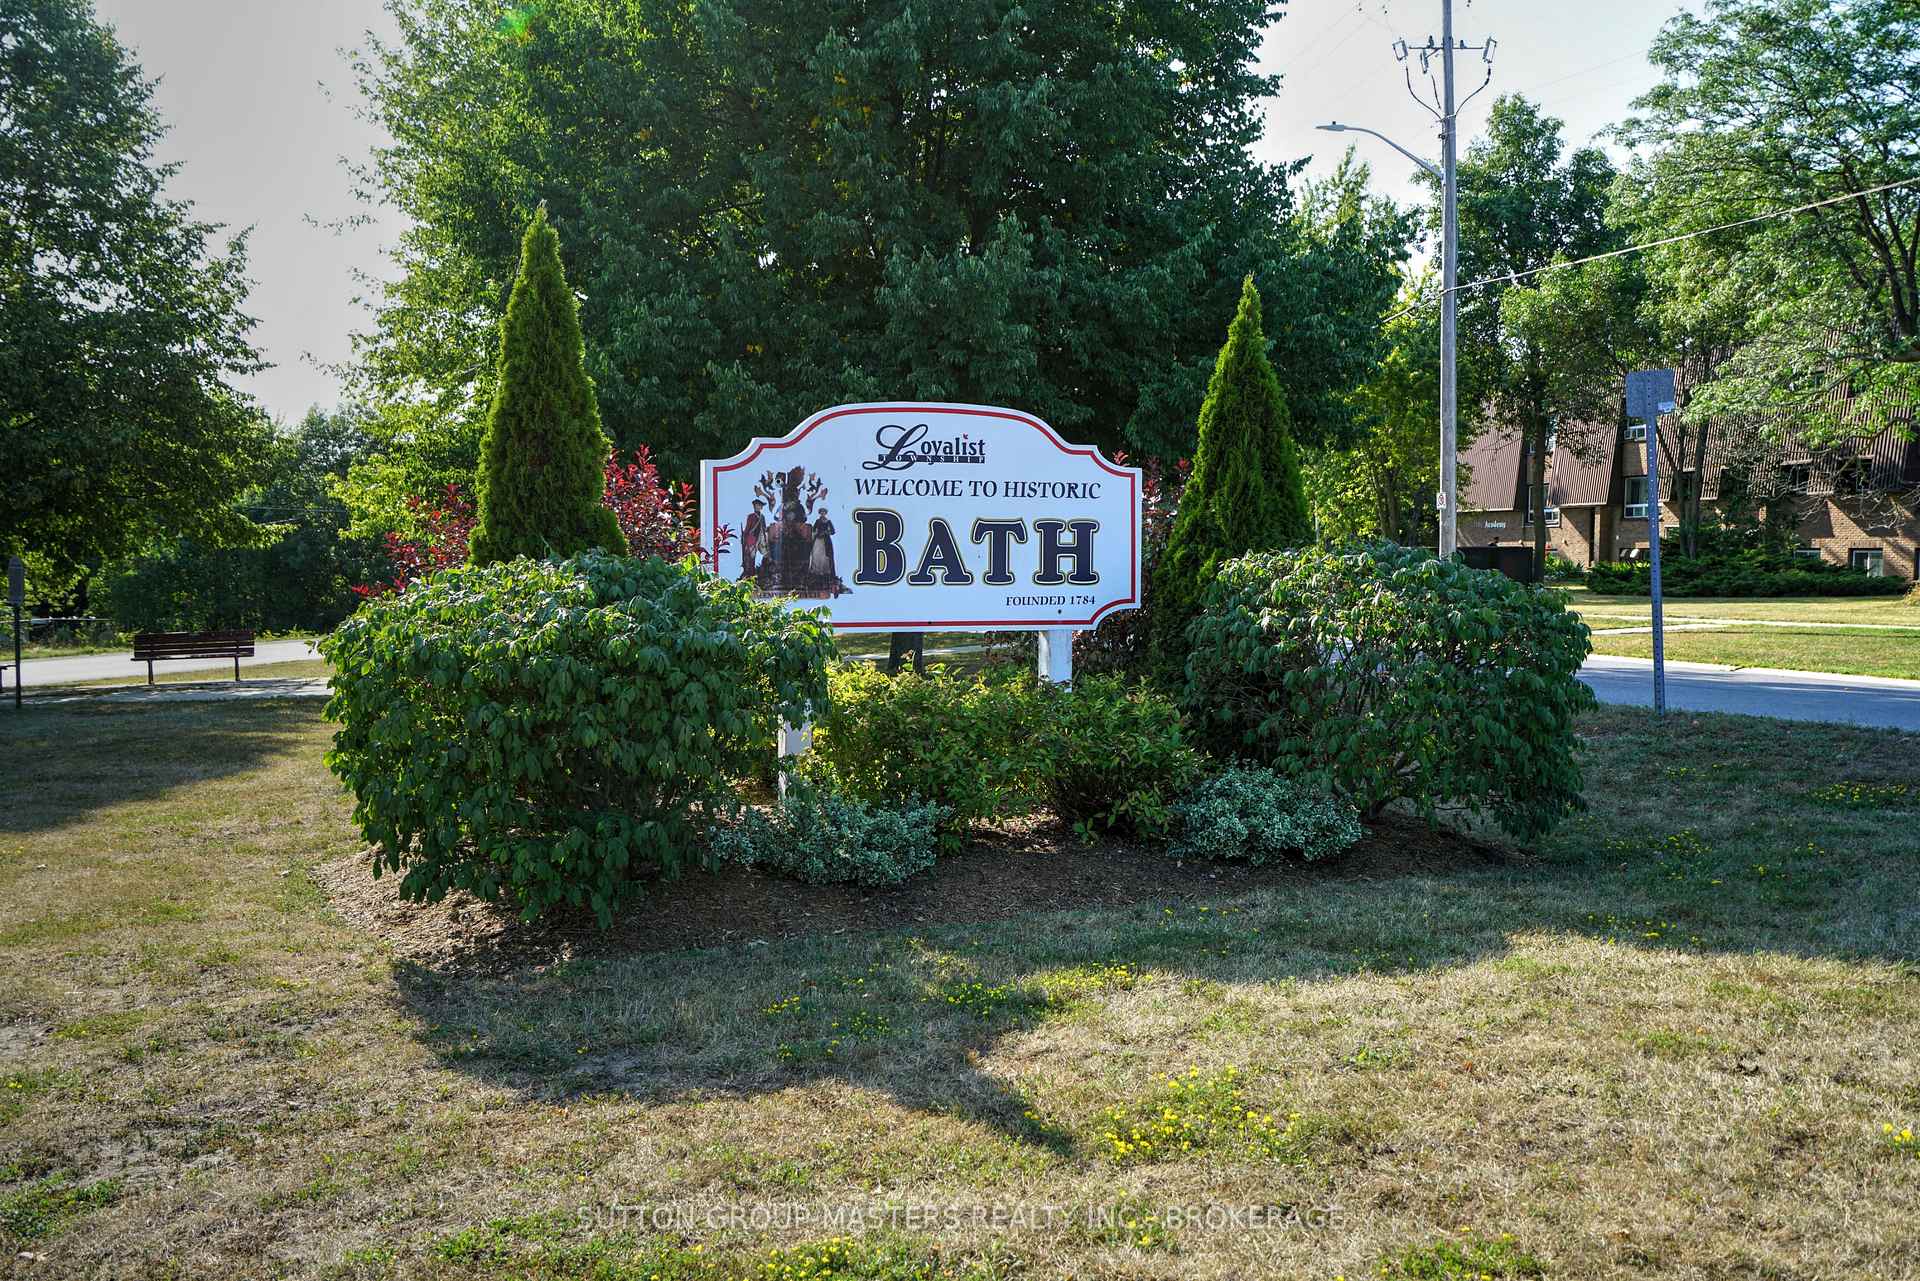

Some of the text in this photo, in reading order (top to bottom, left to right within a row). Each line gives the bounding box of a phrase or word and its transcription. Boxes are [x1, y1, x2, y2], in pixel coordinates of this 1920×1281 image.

[862, 424, 986, 470] Loyalist
[854, 478, 1101, 499] WELCOME TO HISTORIC
[852, 507, 1101, 586] BATH
[1006, 595, 1096, 606] FOUNDED 1784
